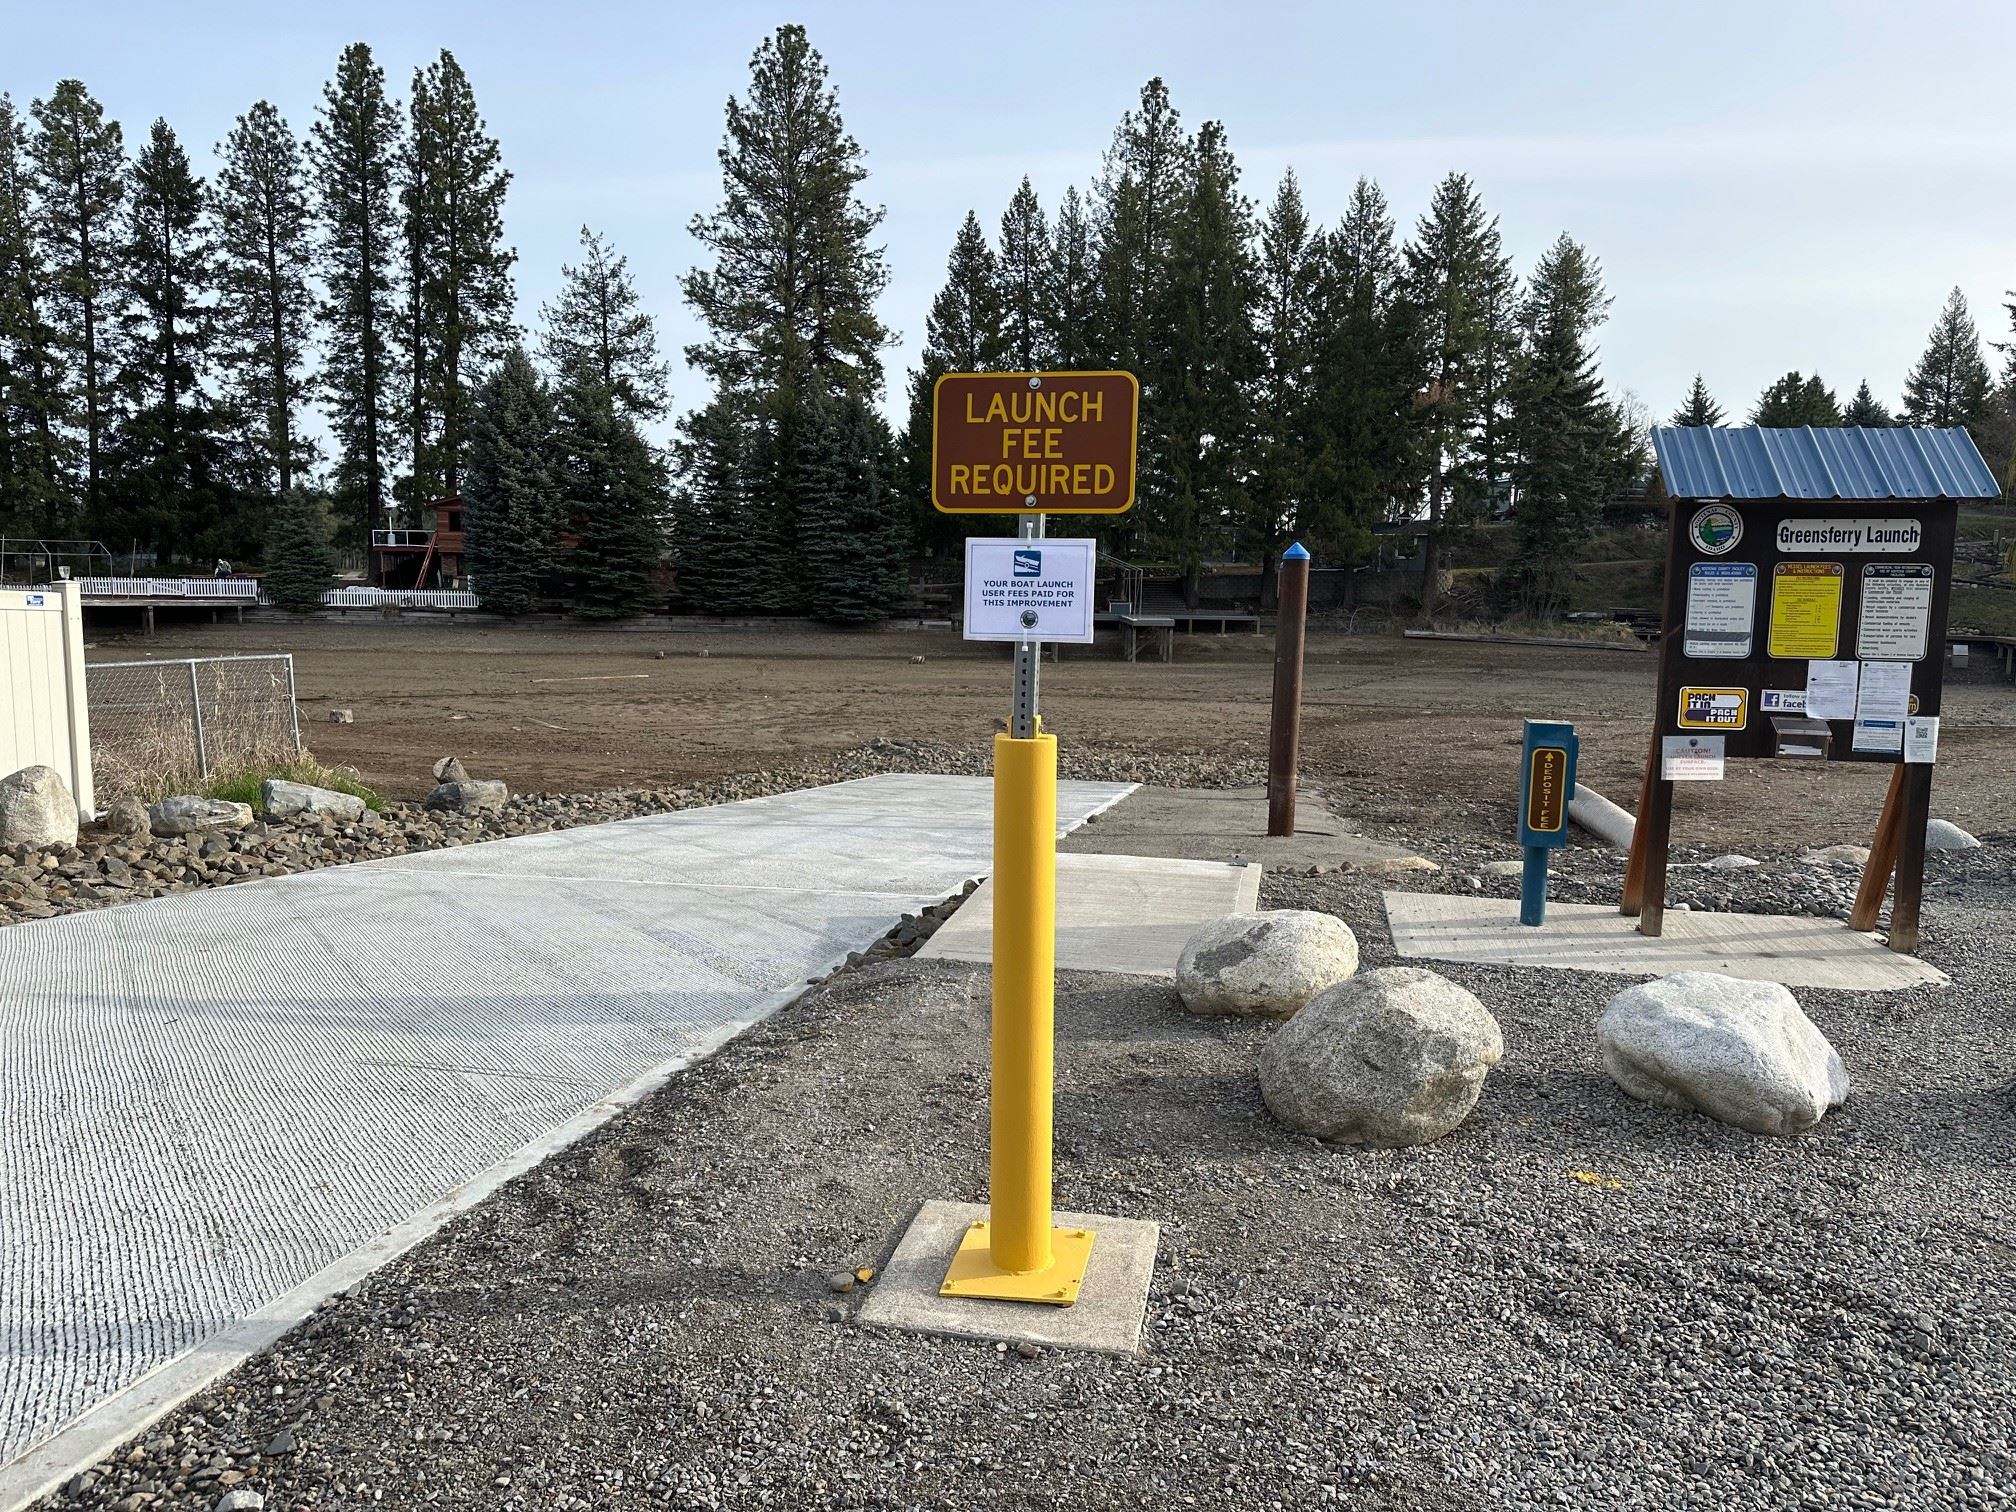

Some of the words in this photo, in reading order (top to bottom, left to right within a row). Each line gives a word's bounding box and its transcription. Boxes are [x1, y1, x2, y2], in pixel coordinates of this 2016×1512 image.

[966, 391, 1102, 423] LAUNCH
[1003, 428, 1063, 458] FEE
[950, 464, 1114, 495] REQUIRED
[1780, 526, 1862, 546] Greensferry
[1866, 526, 1918, 543] Launch
[1542, 762, 1553, 806] DEPOSIT
[1540, 810, 1549, 828] FEE
